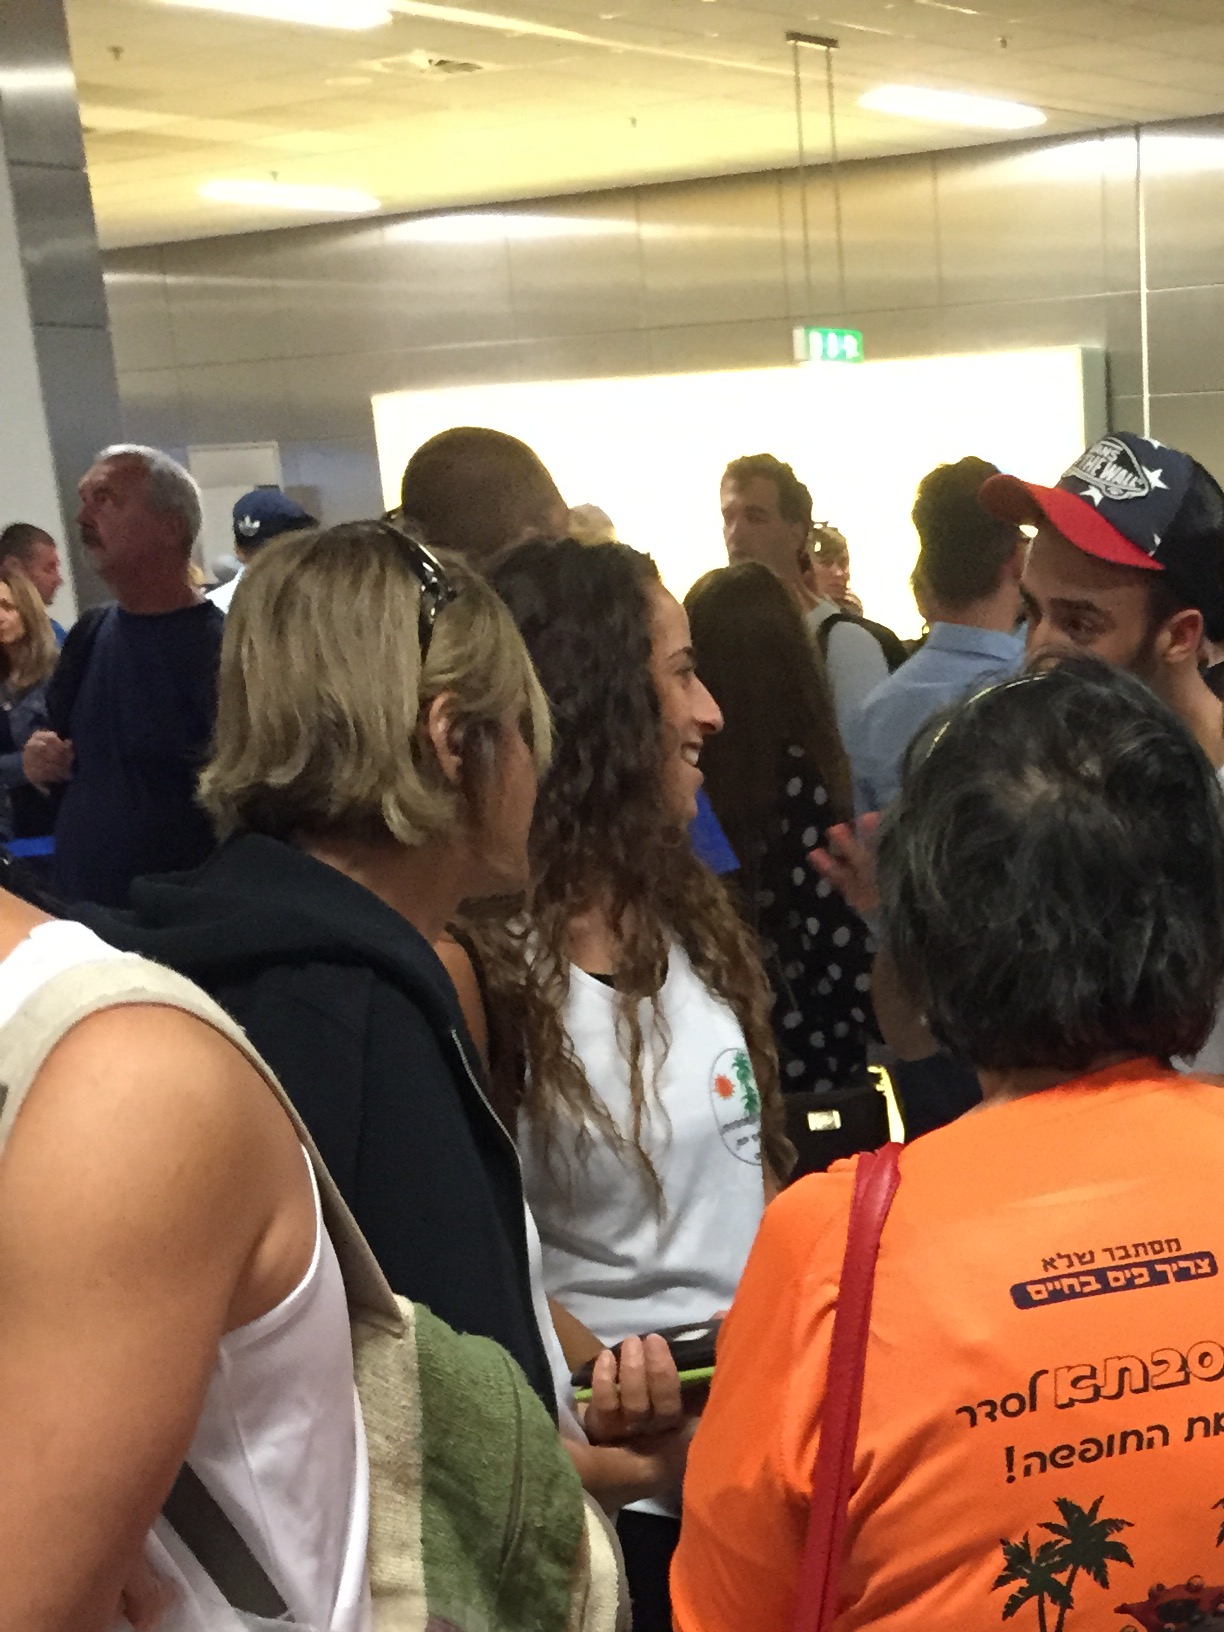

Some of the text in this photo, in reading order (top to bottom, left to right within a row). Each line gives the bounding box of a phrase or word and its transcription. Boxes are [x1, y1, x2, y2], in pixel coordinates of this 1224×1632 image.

[1099, 460, 1140, 488] WALL
[1041, 1237, 1182, 1273] מסתבר שלא
[1154, 1257, 1211, 1285] צריך
[1026, 1275, 1103, 1301] בחיים
[955, 1368, 1049, 1428] לסדר
[1004, 1423, 1170, 1484] החופשה!
